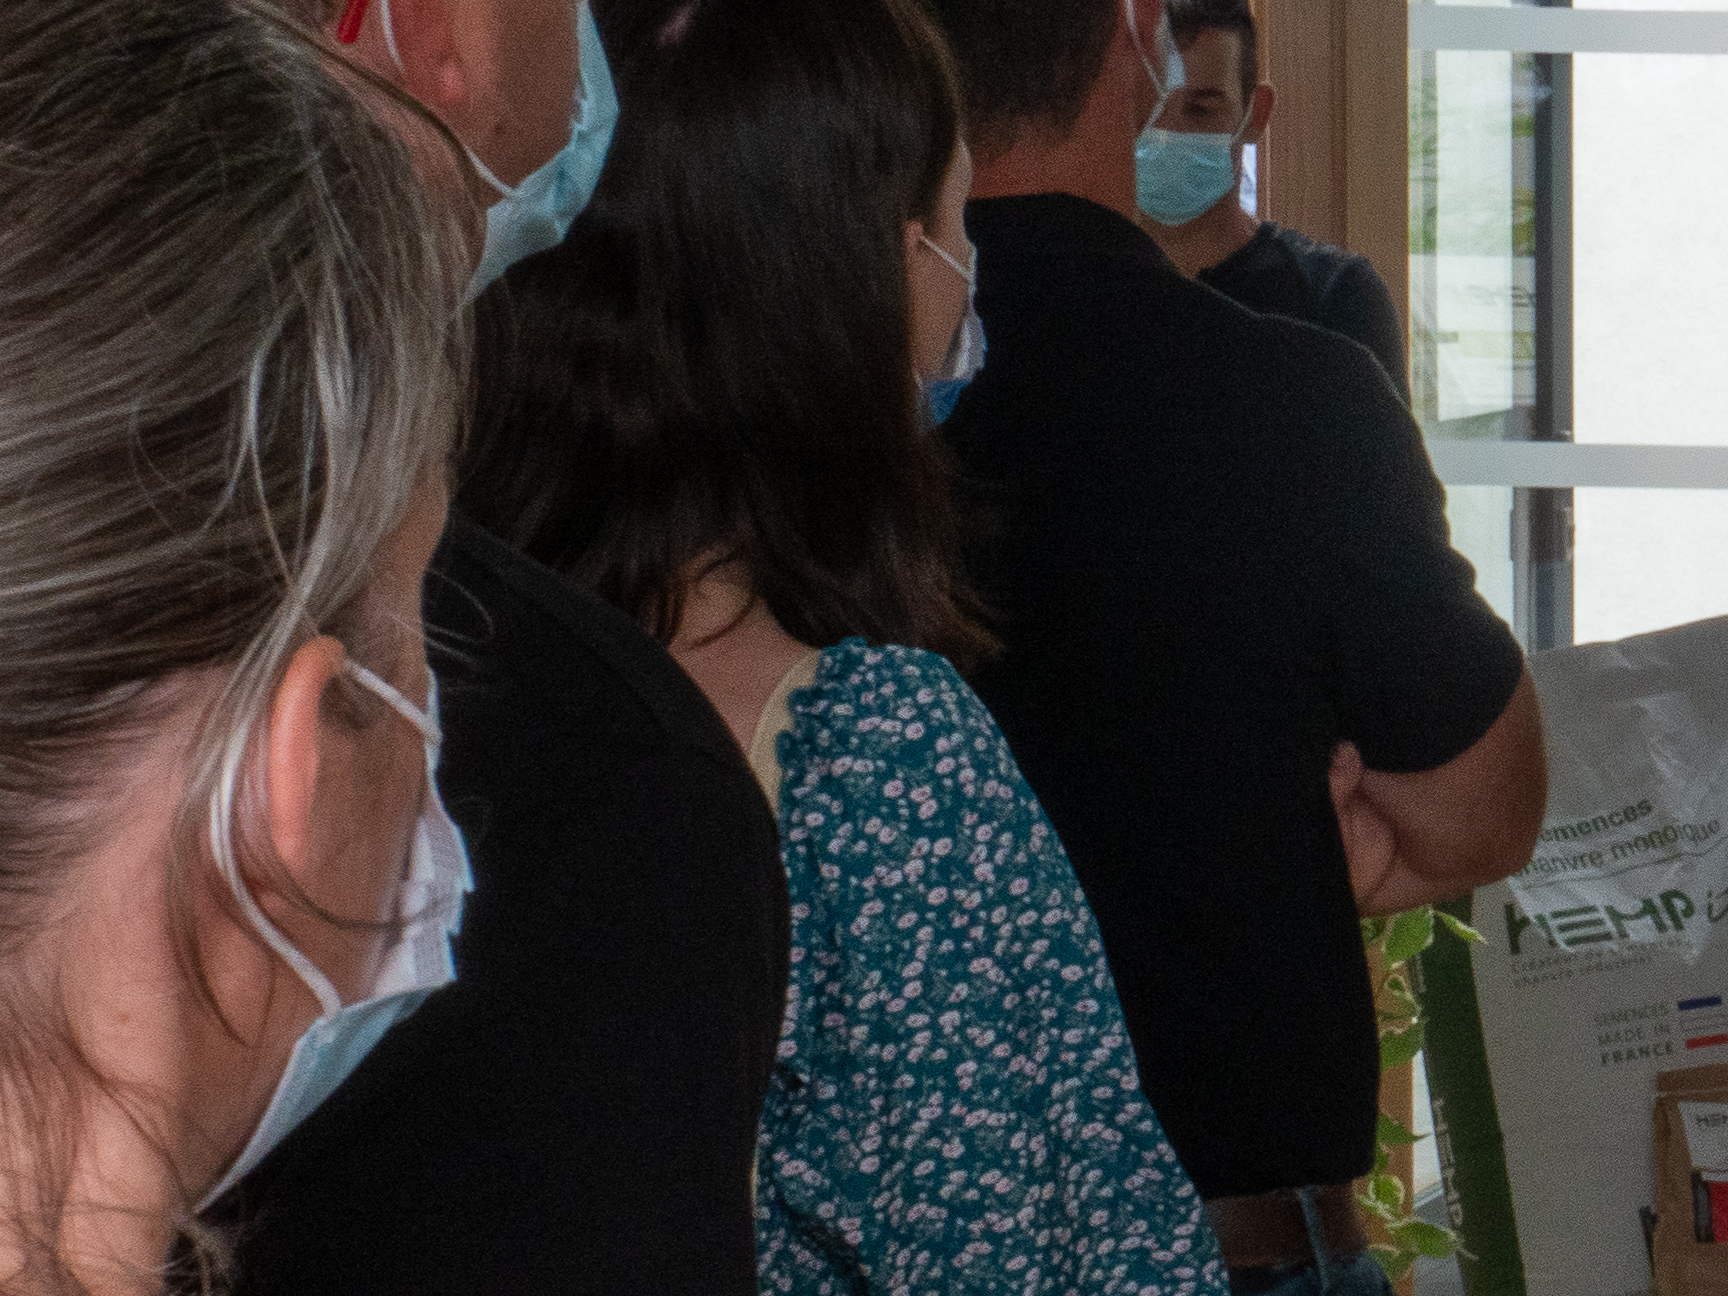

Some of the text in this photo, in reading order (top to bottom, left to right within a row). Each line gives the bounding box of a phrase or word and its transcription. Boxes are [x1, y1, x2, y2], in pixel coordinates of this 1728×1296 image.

[1538, 800, 1653, 843] emences
[1597, 1027, 1645, 1046] MADE
[1600, 1040, 1674, 1066] FRANCE
